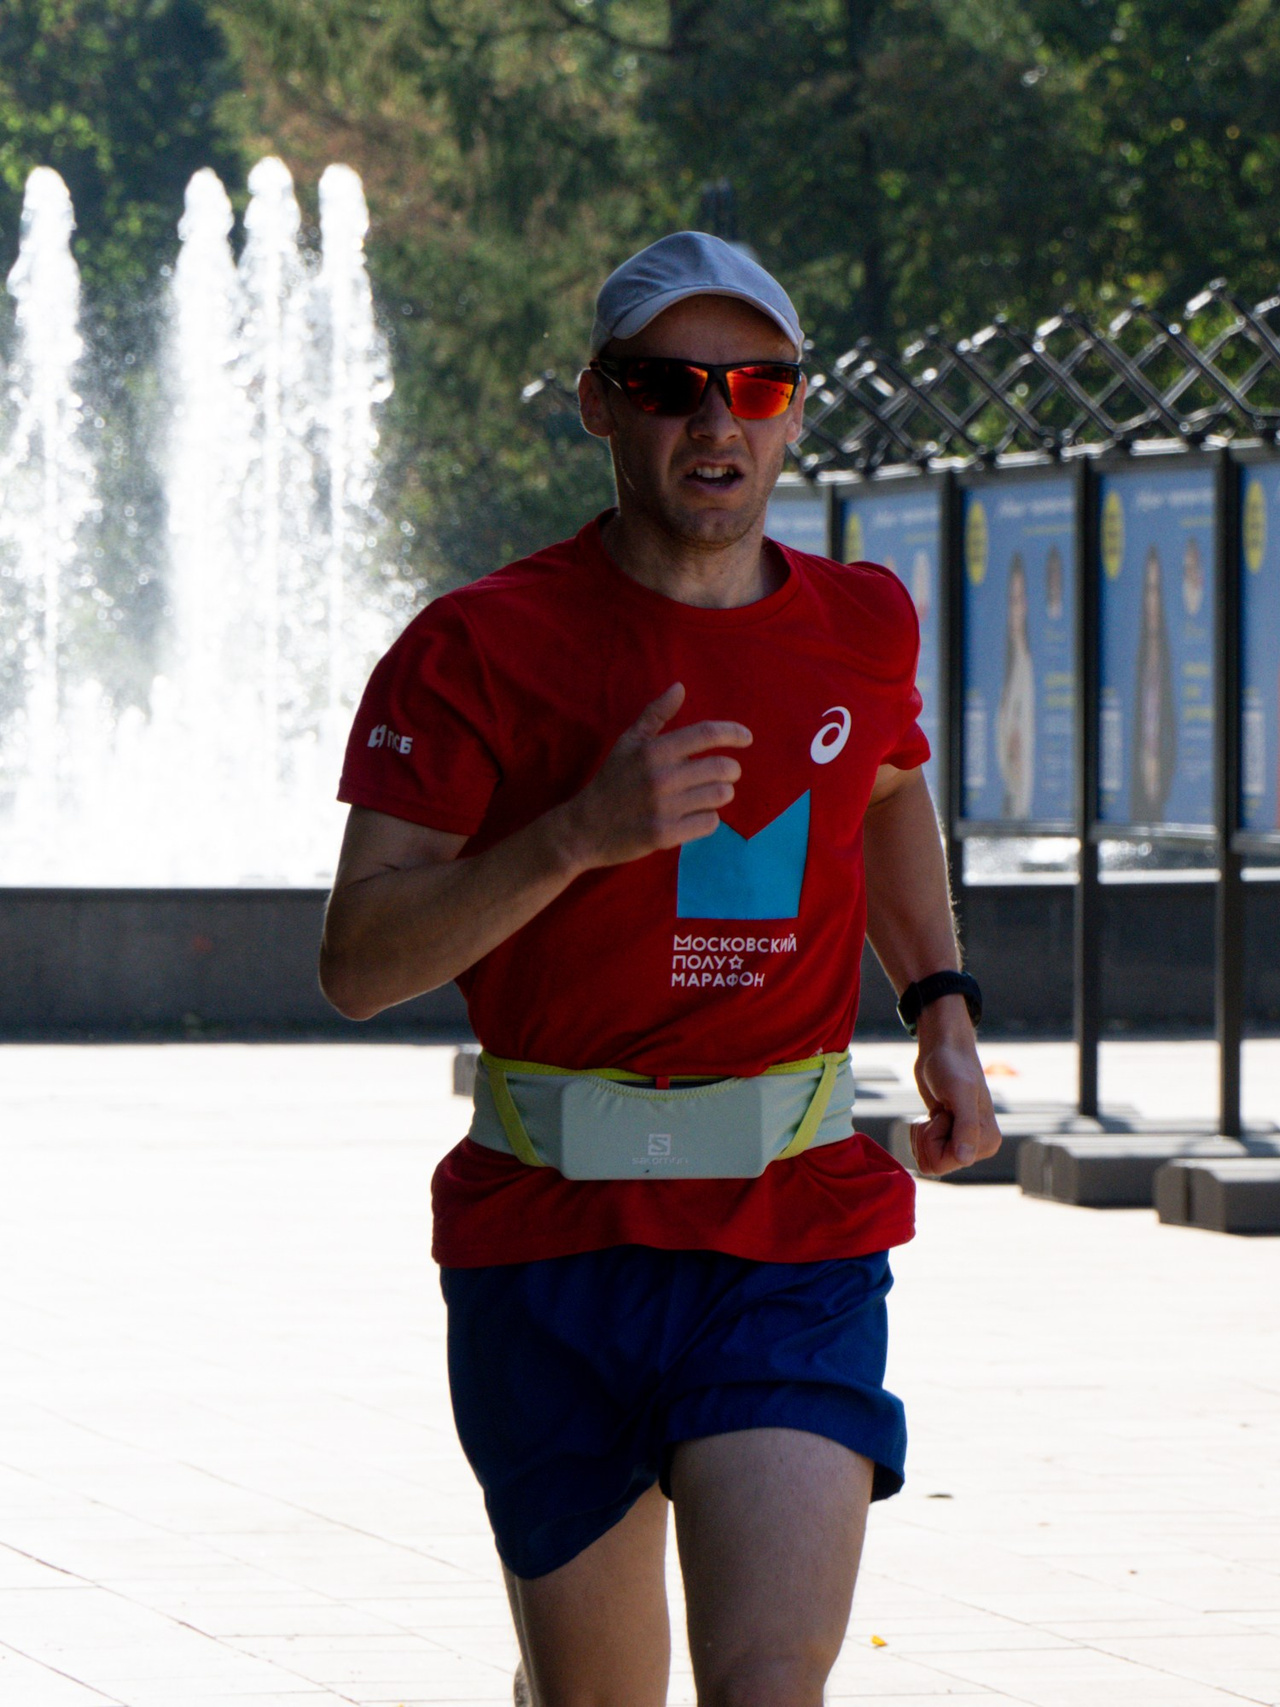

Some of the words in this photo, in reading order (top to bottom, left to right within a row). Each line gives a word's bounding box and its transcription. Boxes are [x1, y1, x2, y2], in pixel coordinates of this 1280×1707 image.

[673, 933, 797, 953] МОСКОВСКИЙ
[672, 955, 727, 969] ПОЛУ
[671, 971, 766, 987] МАРАФОН
